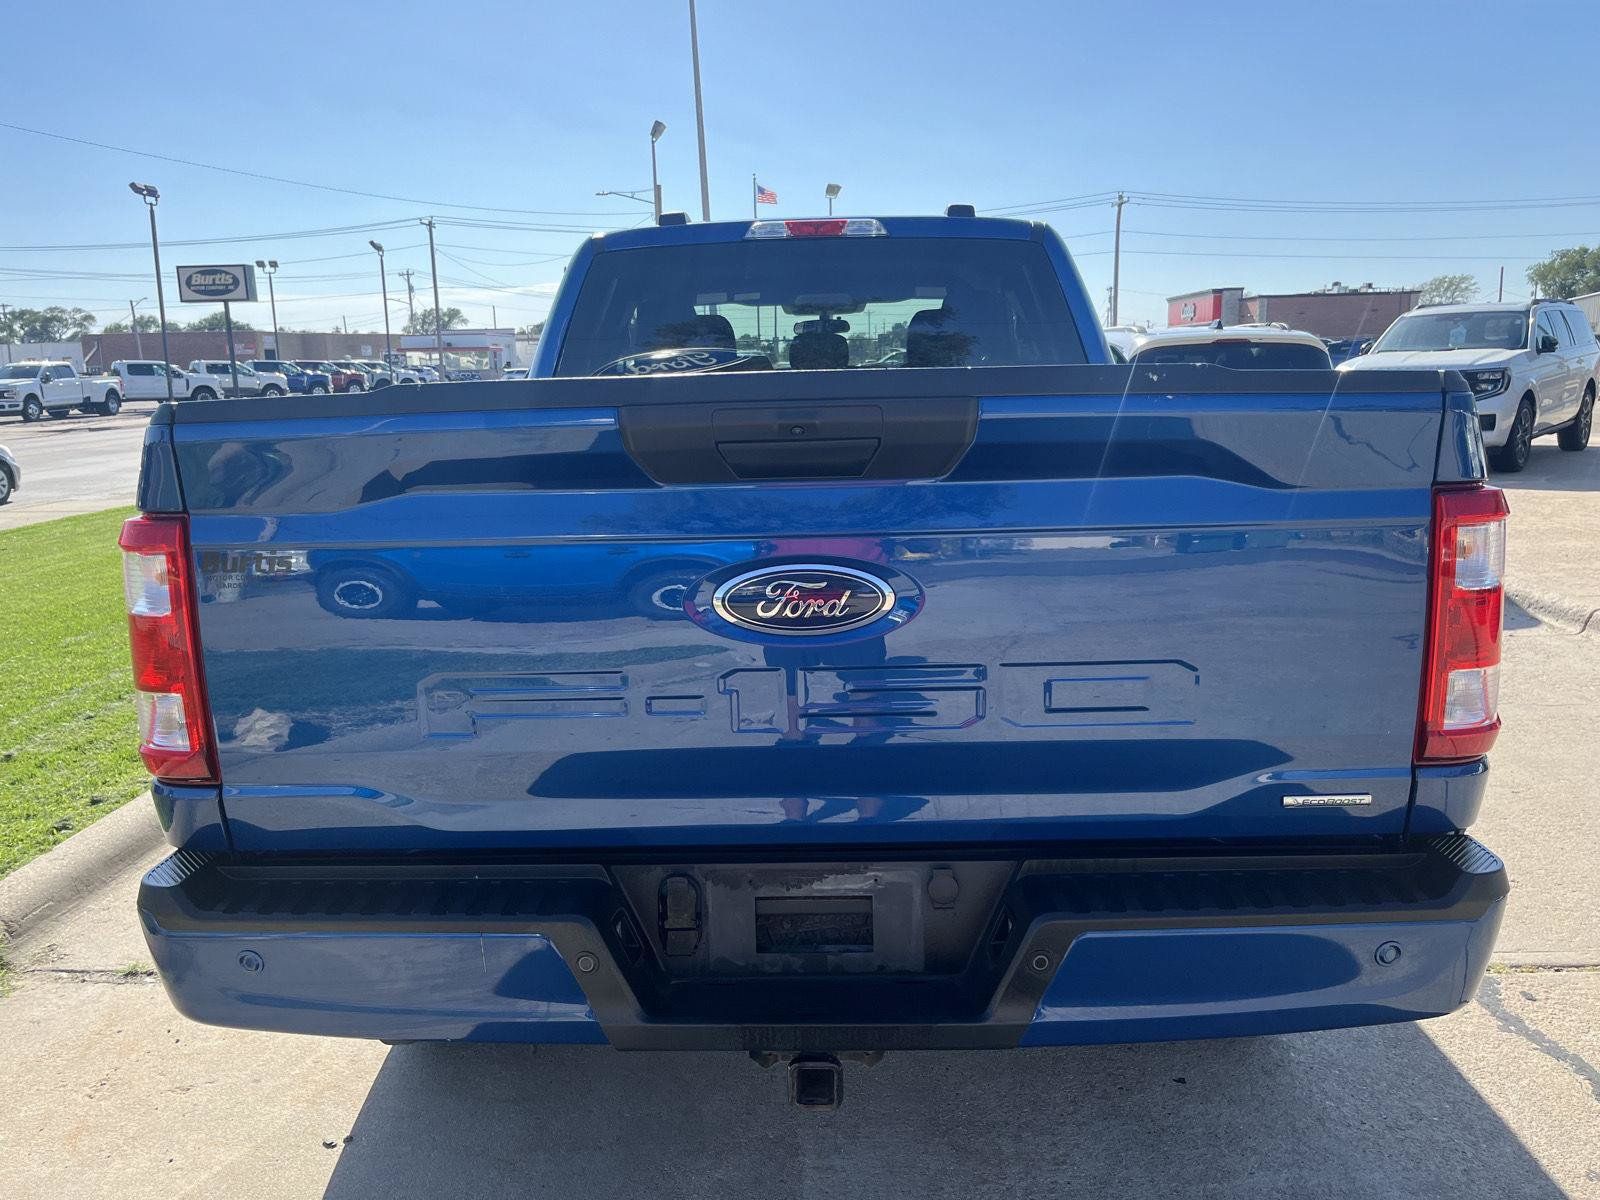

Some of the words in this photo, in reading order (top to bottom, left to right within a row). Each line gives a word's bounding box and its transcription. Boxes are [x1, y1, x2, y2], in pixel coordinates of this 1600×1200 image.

[191, 273, 234, 284] Burtis
[201, 551, 293, 573] Burtis
[756, 580, 851, 619] Ford
[416, 661, 1199, 736] F-150
